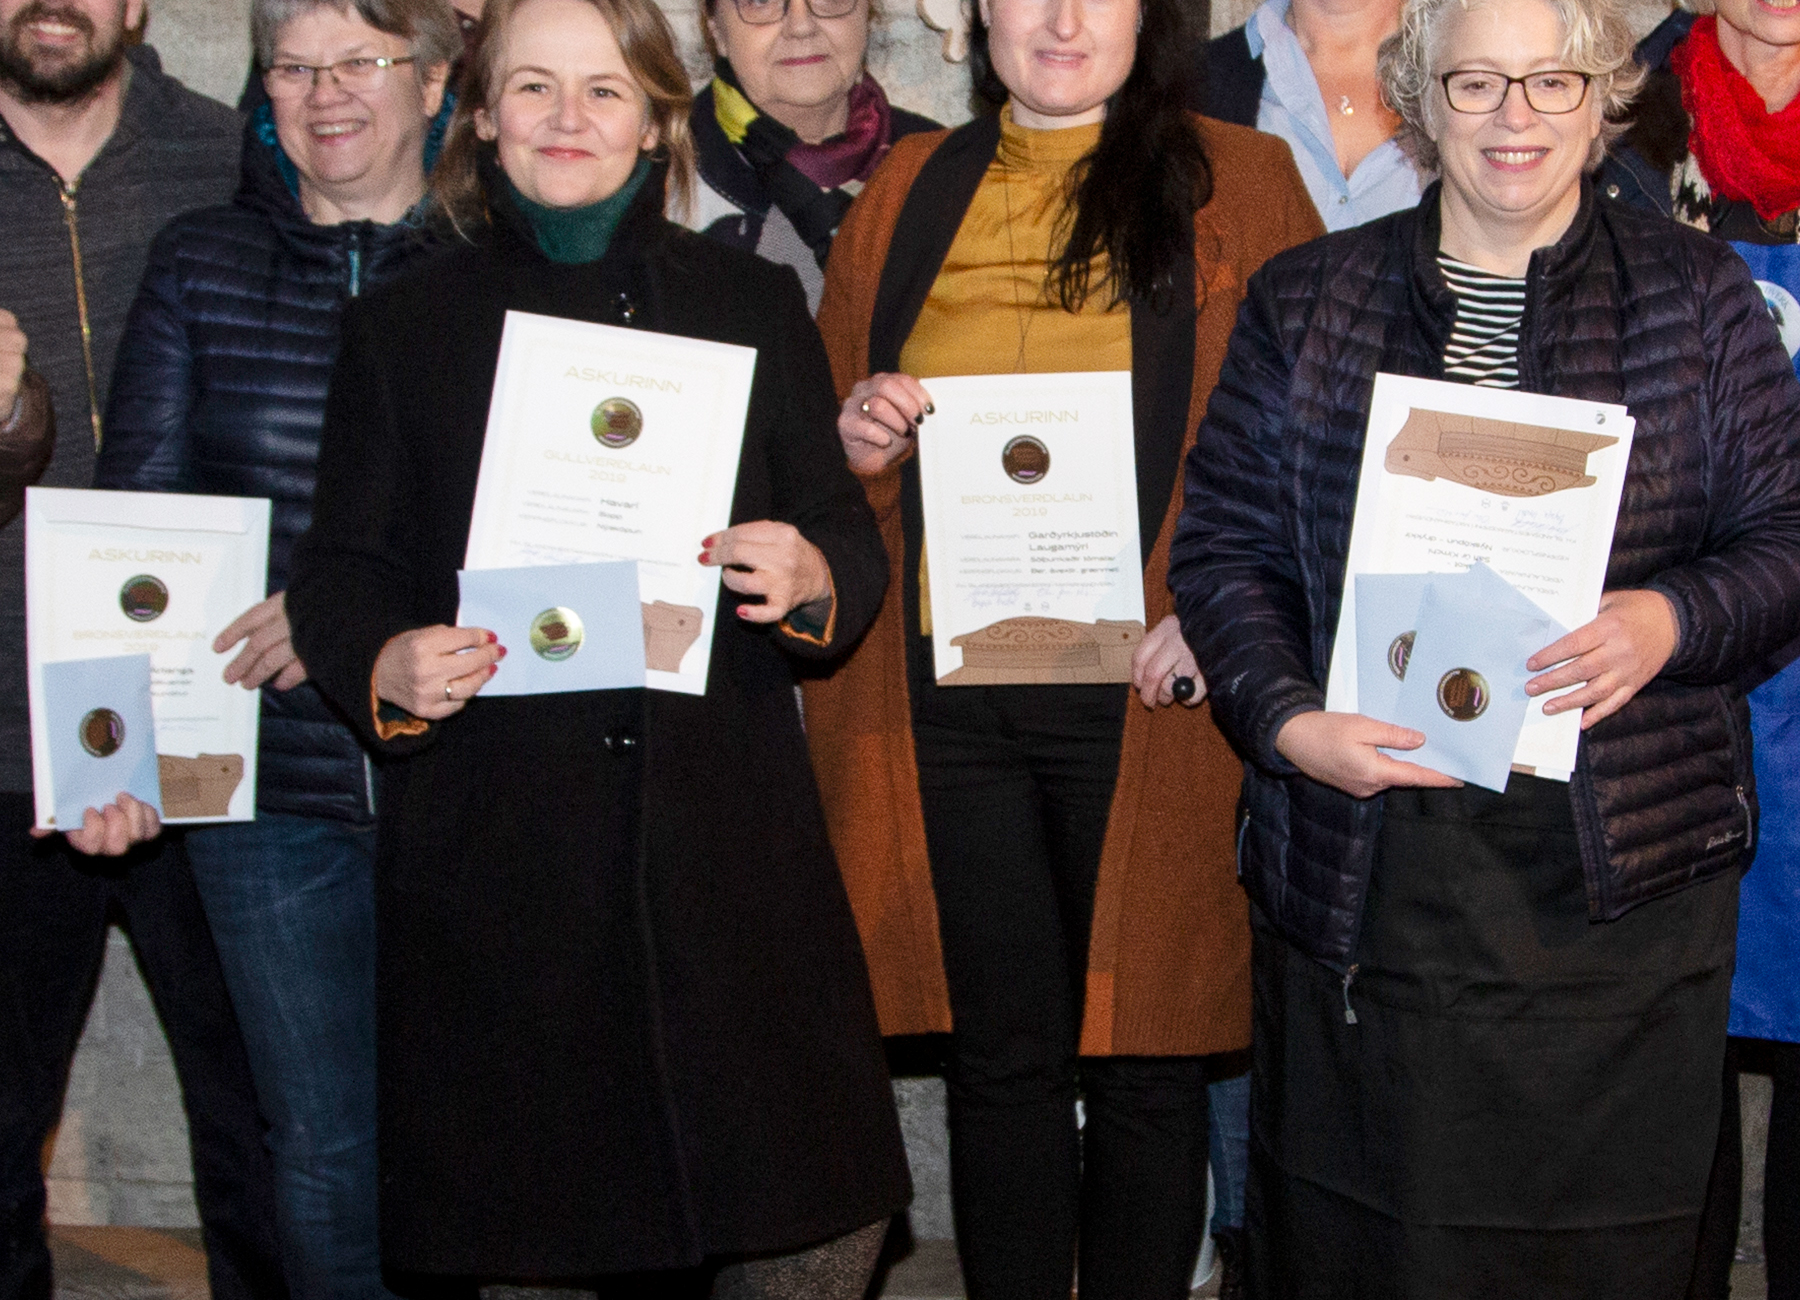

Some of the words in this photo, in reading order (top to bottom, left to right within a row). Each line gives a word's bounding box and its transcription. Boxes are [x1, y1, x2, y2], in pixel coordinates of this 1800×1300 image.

[564, 365, 683, 394] ASKURINN
[970, 410, 1079, 425] ASKURINN
[1013, 507, 1048, 517] 2019
[88, 548, 202, 565] ASKURINN
